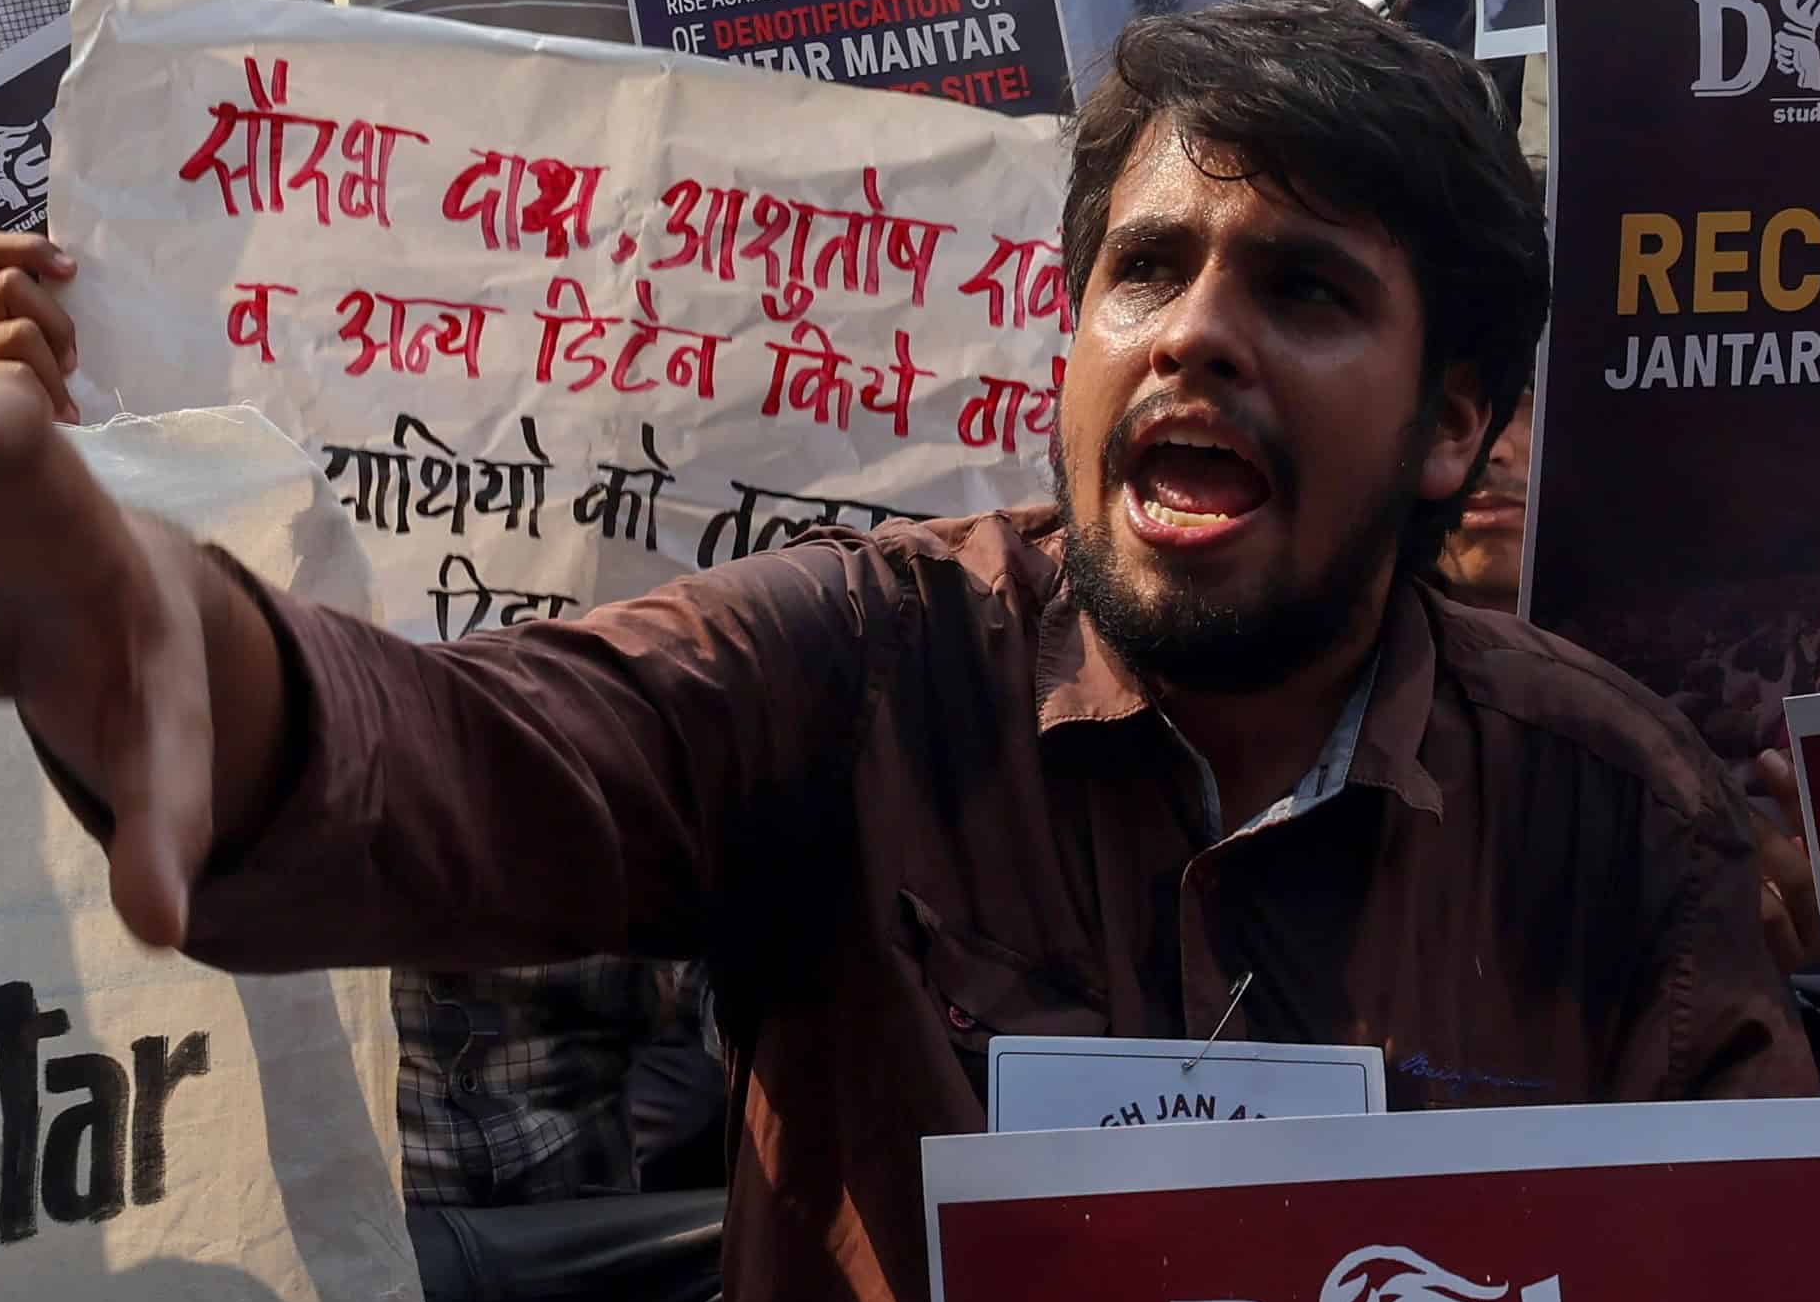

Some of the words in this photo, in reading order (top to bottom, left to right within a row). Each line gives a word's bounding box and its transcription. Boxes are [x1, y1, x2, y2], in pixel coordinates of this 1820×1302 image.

[671, 22, 707, 55] OF
[842, 13, 1021, 78] MANTAR
[179, 56, 430, 228] सौरभ
[648, 166, 958, 322] आशुतोष
[226, 283, 299, 364] व
[336, 288, 506, 380] अन्य
[533, 276, 733, 400] डिटेन
[761, 319, 939, 439] किये
[573, 421, 675, 552] को
[1155, 1093, 1216, 1121] JAN
